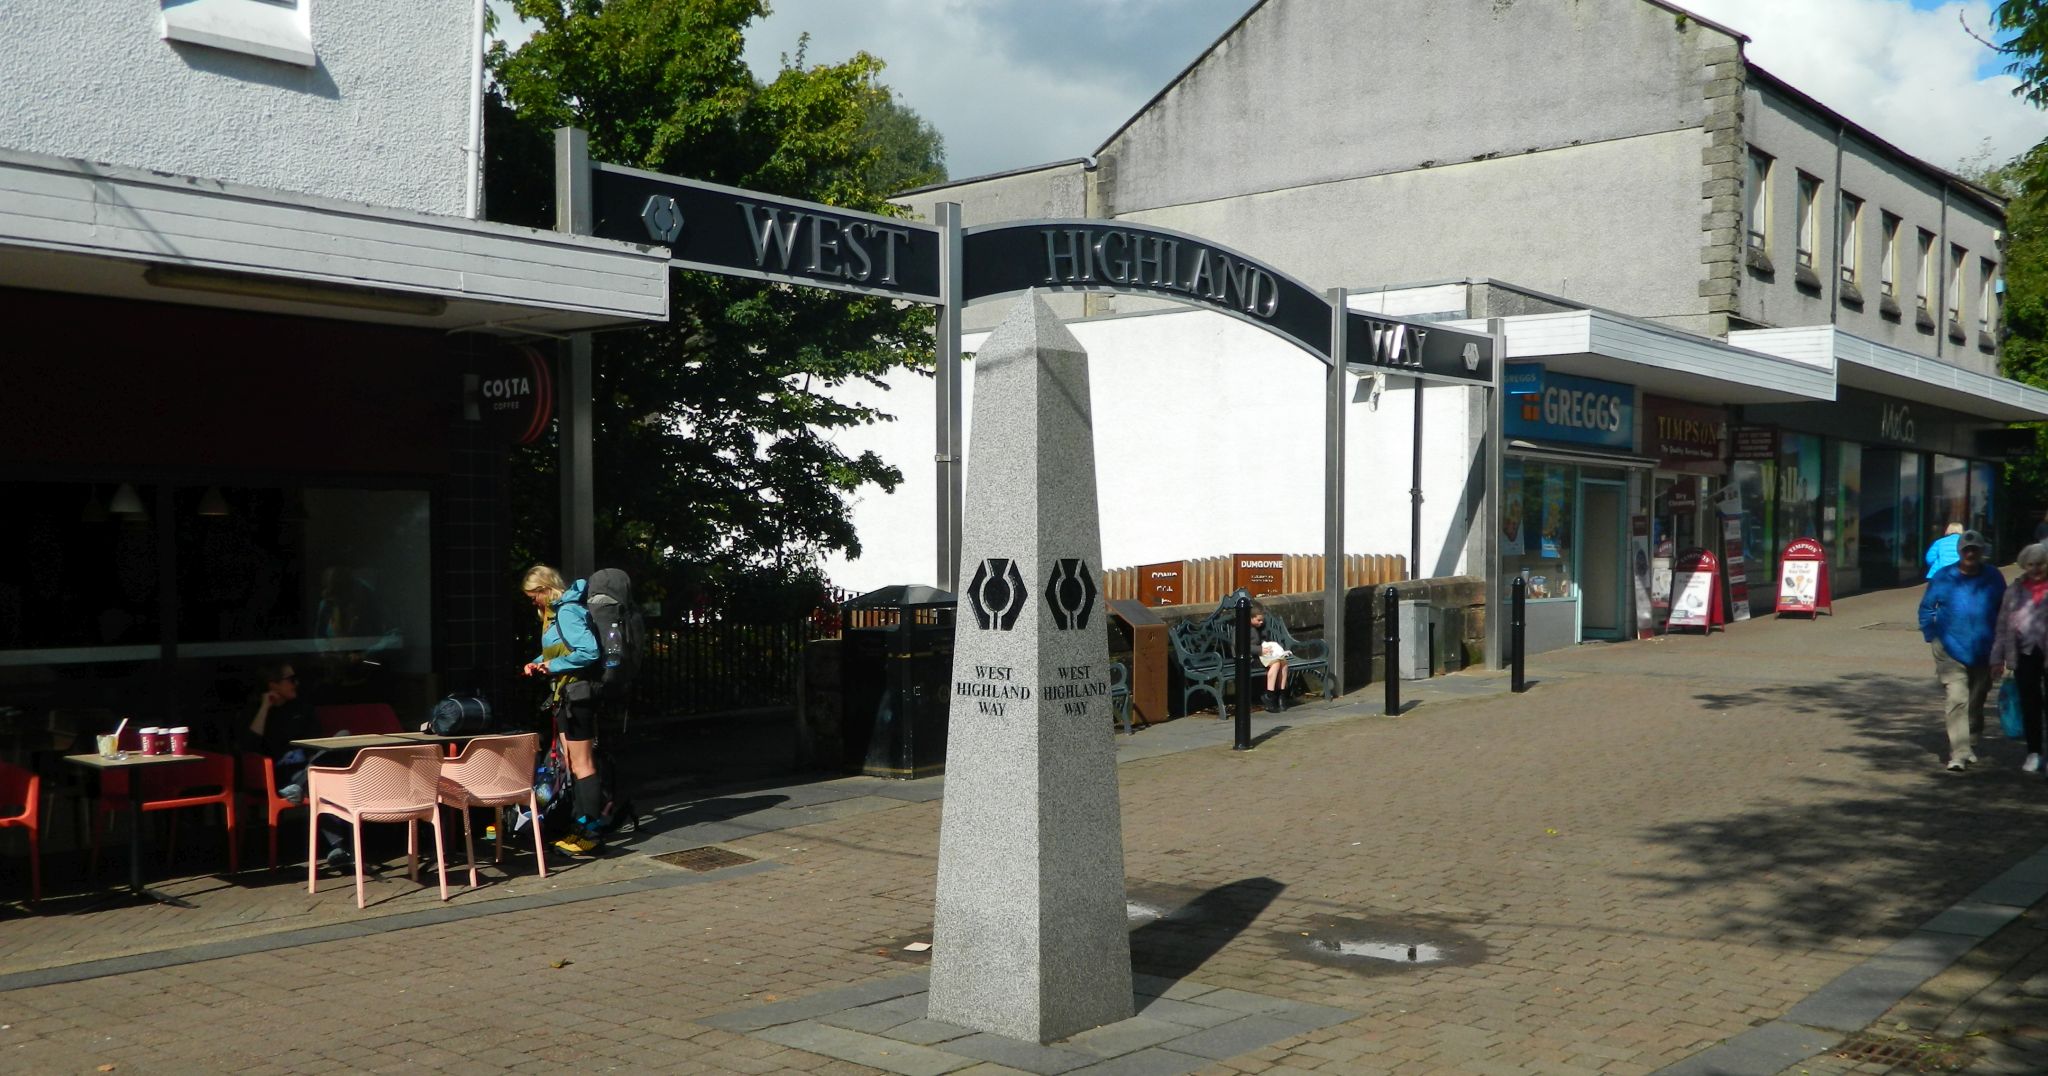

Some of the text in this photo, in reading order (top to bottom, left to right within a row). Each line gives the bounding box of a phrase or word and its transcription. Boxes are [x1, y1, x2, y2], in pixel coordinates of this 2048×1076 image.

[735, 201, 1431, 368] WEST HIGHLAND WAY
[483, 377, 530, 399] COSTA
[1543, 386, 1621, 432] GREGGS
[1657, 416, 1719, 445] TIMPSON
[1787, 543, 1818, 554] TIMPSON
[1240, 560, 1284, 569] DUMGOYNE
[975, 665, 1012, 681] WEST
[1057, 665, 1091, 681] WEST
[956, 682, 1031, 700] HIGHLAND
[1043, 682, 1108, 701] HIGHLAND
[978, 701, 1006, 717] WAY
[1063, 701, 1089, 717] WAY
